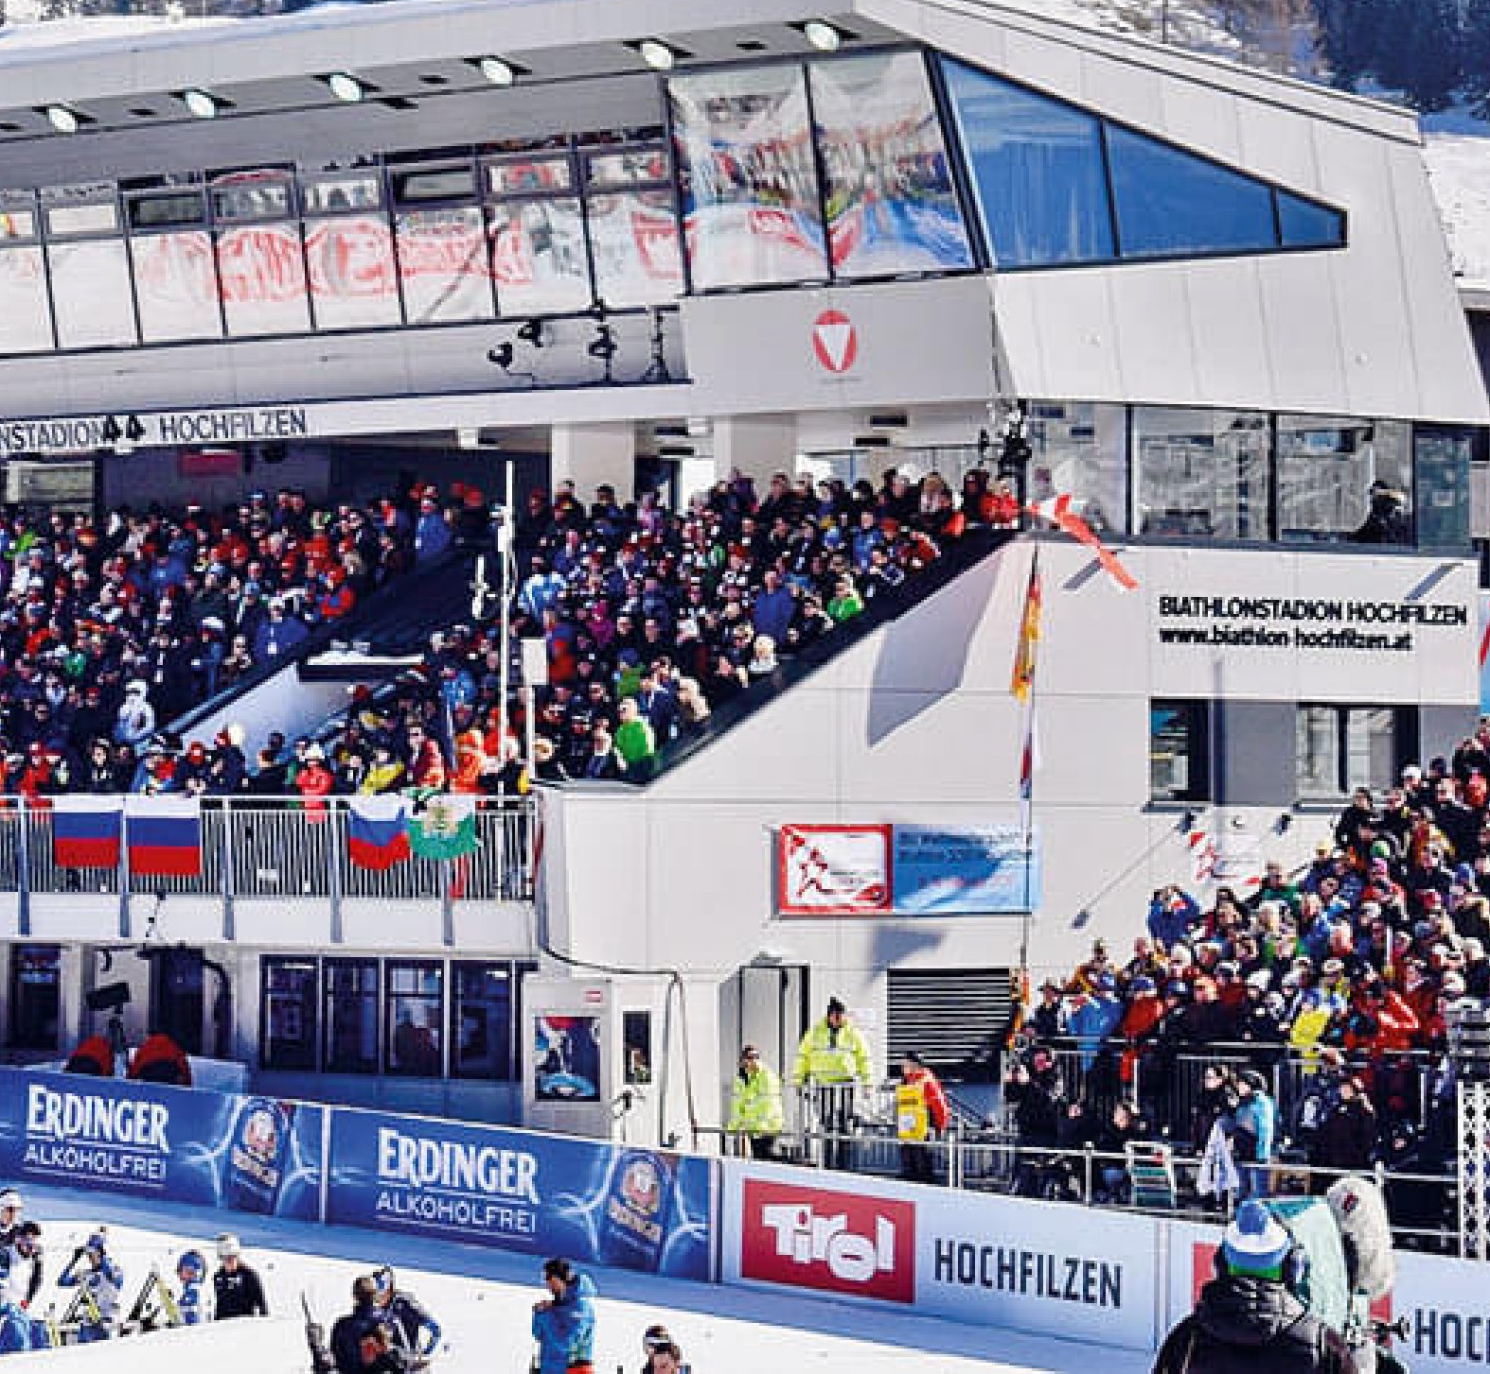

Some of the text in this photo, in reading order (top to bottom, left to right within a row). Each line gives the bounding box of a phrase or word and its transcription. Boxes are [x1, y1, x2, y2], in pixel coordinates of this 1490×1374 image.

[160, 409, 307, 440] HOCHFILZEN
[1159, 596, 1467, 626] BIATHLONSTADION HOCHFILZEN
[1159, 624, 1413, 651] www.biathlon-hochfilzen.at
[27, 1084, 170, 1153] ERDINGER
[24, 1144, 167, 1179] ALKOHOLFREI
[378, 1127, 541, 1204] ERDINGER
[376, 1190, 536, 1233] ALKOHOLFREI
[762, 1203, 897, 1282] Tirol
[934, 1237, 1123, 1309] HOCHFILZEN
